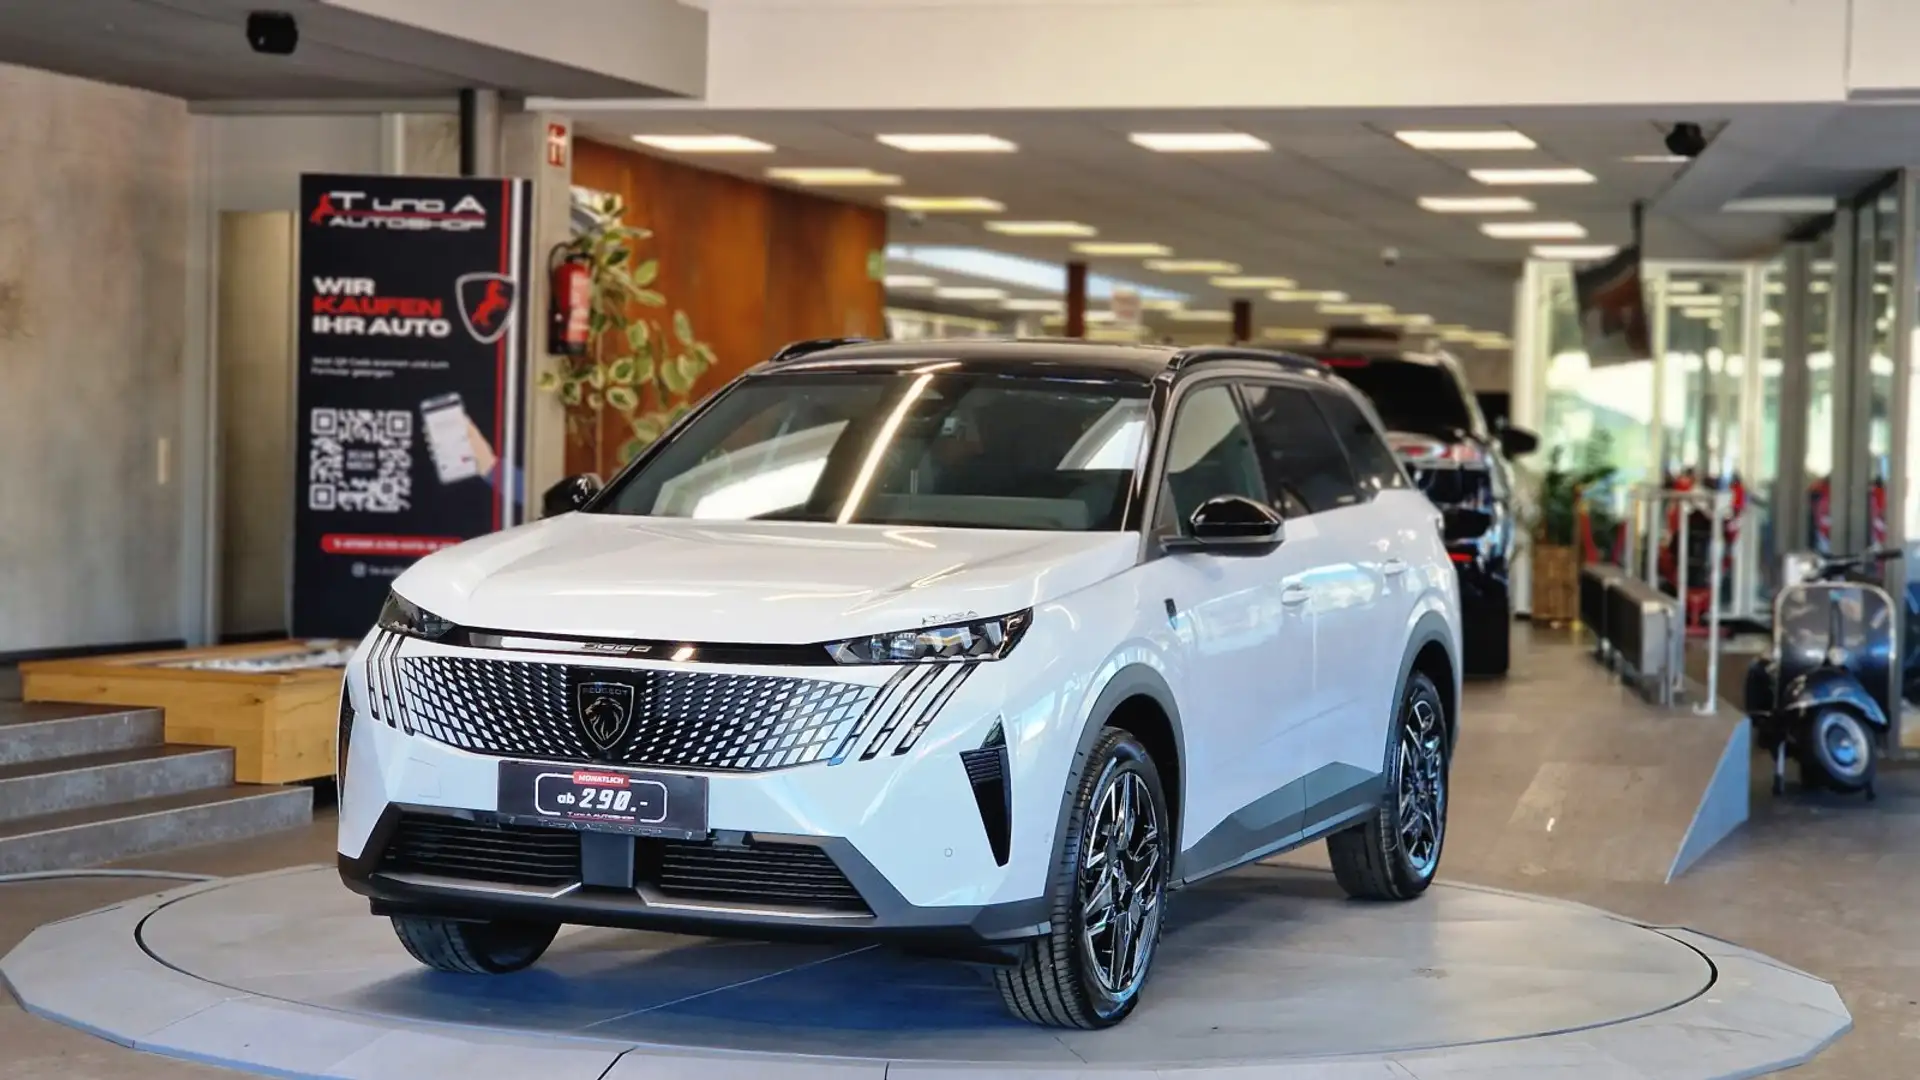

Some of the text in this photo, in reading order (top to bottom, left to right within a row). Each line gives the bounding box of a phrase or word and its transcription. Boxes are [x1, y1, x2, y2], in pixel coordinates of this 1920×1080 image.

[329, 191, 365, 210] T
[451, 195, 486, 214] A
[312, 276, 375, 295] WIR
[313, 297, 442, 316] KAUFEN
[312, 316, 451, 338] IHR AUTO
[578, 775, 624, 784] MONATLICH
[557, 792, 575, 805] ab
